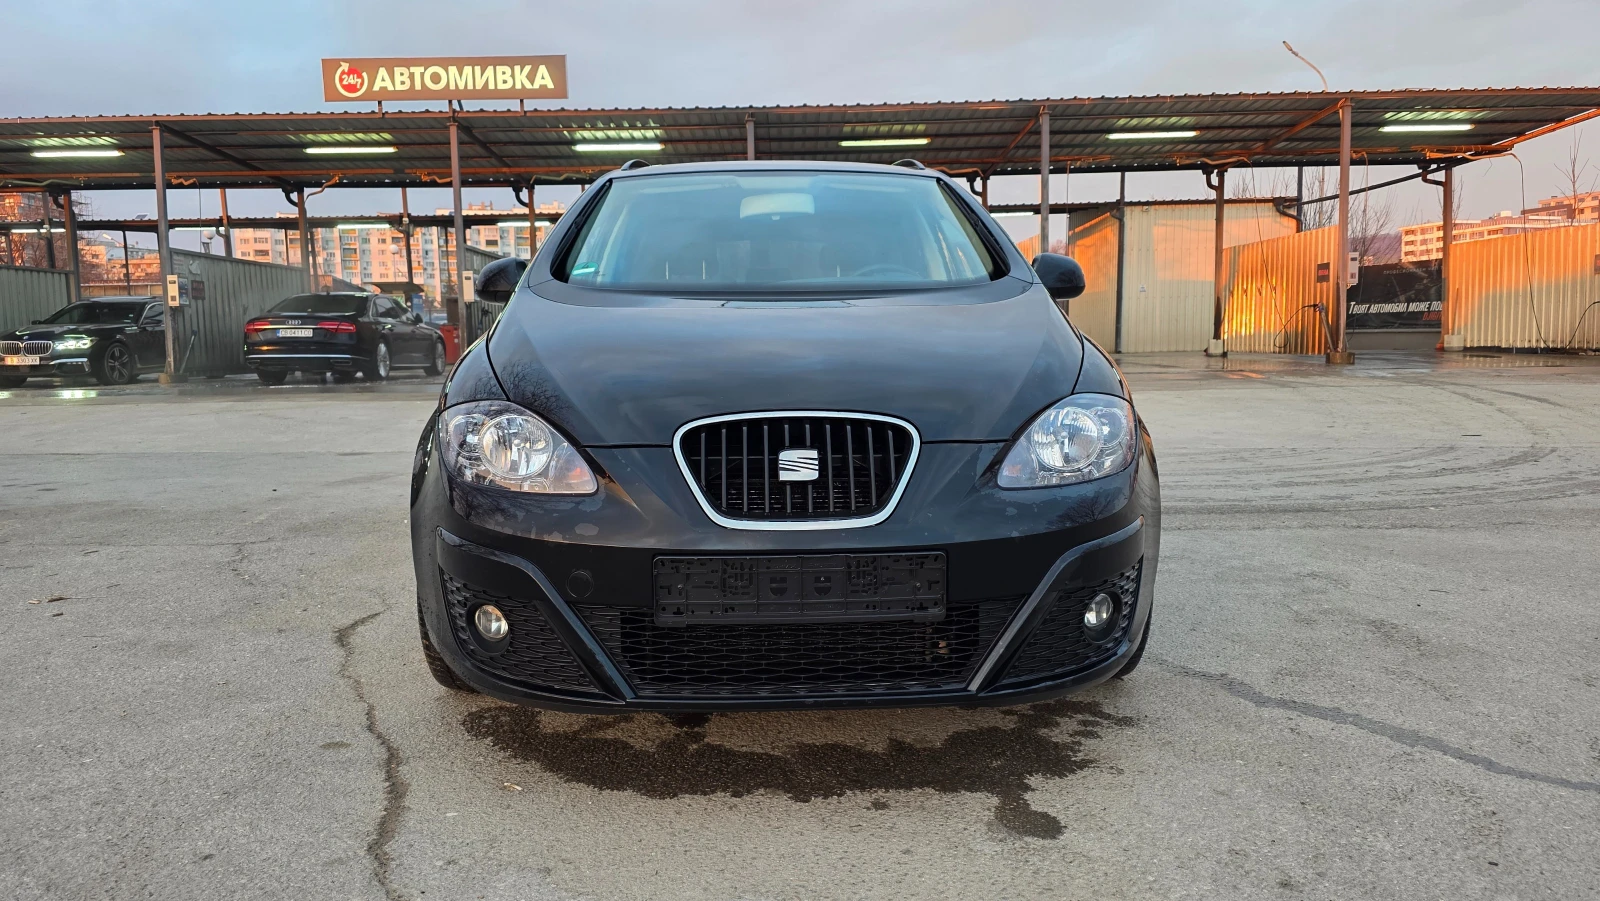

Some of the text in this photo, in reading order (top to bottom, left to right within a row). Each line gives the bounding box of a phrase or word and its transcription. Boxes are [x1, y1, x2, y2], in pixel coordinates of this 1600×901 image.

[341, 73, 362, 89] 24/7
[372, 64, 555, 91] АВТОМИВКА
[1407, 301, 1431, 312] МОЖЕ
